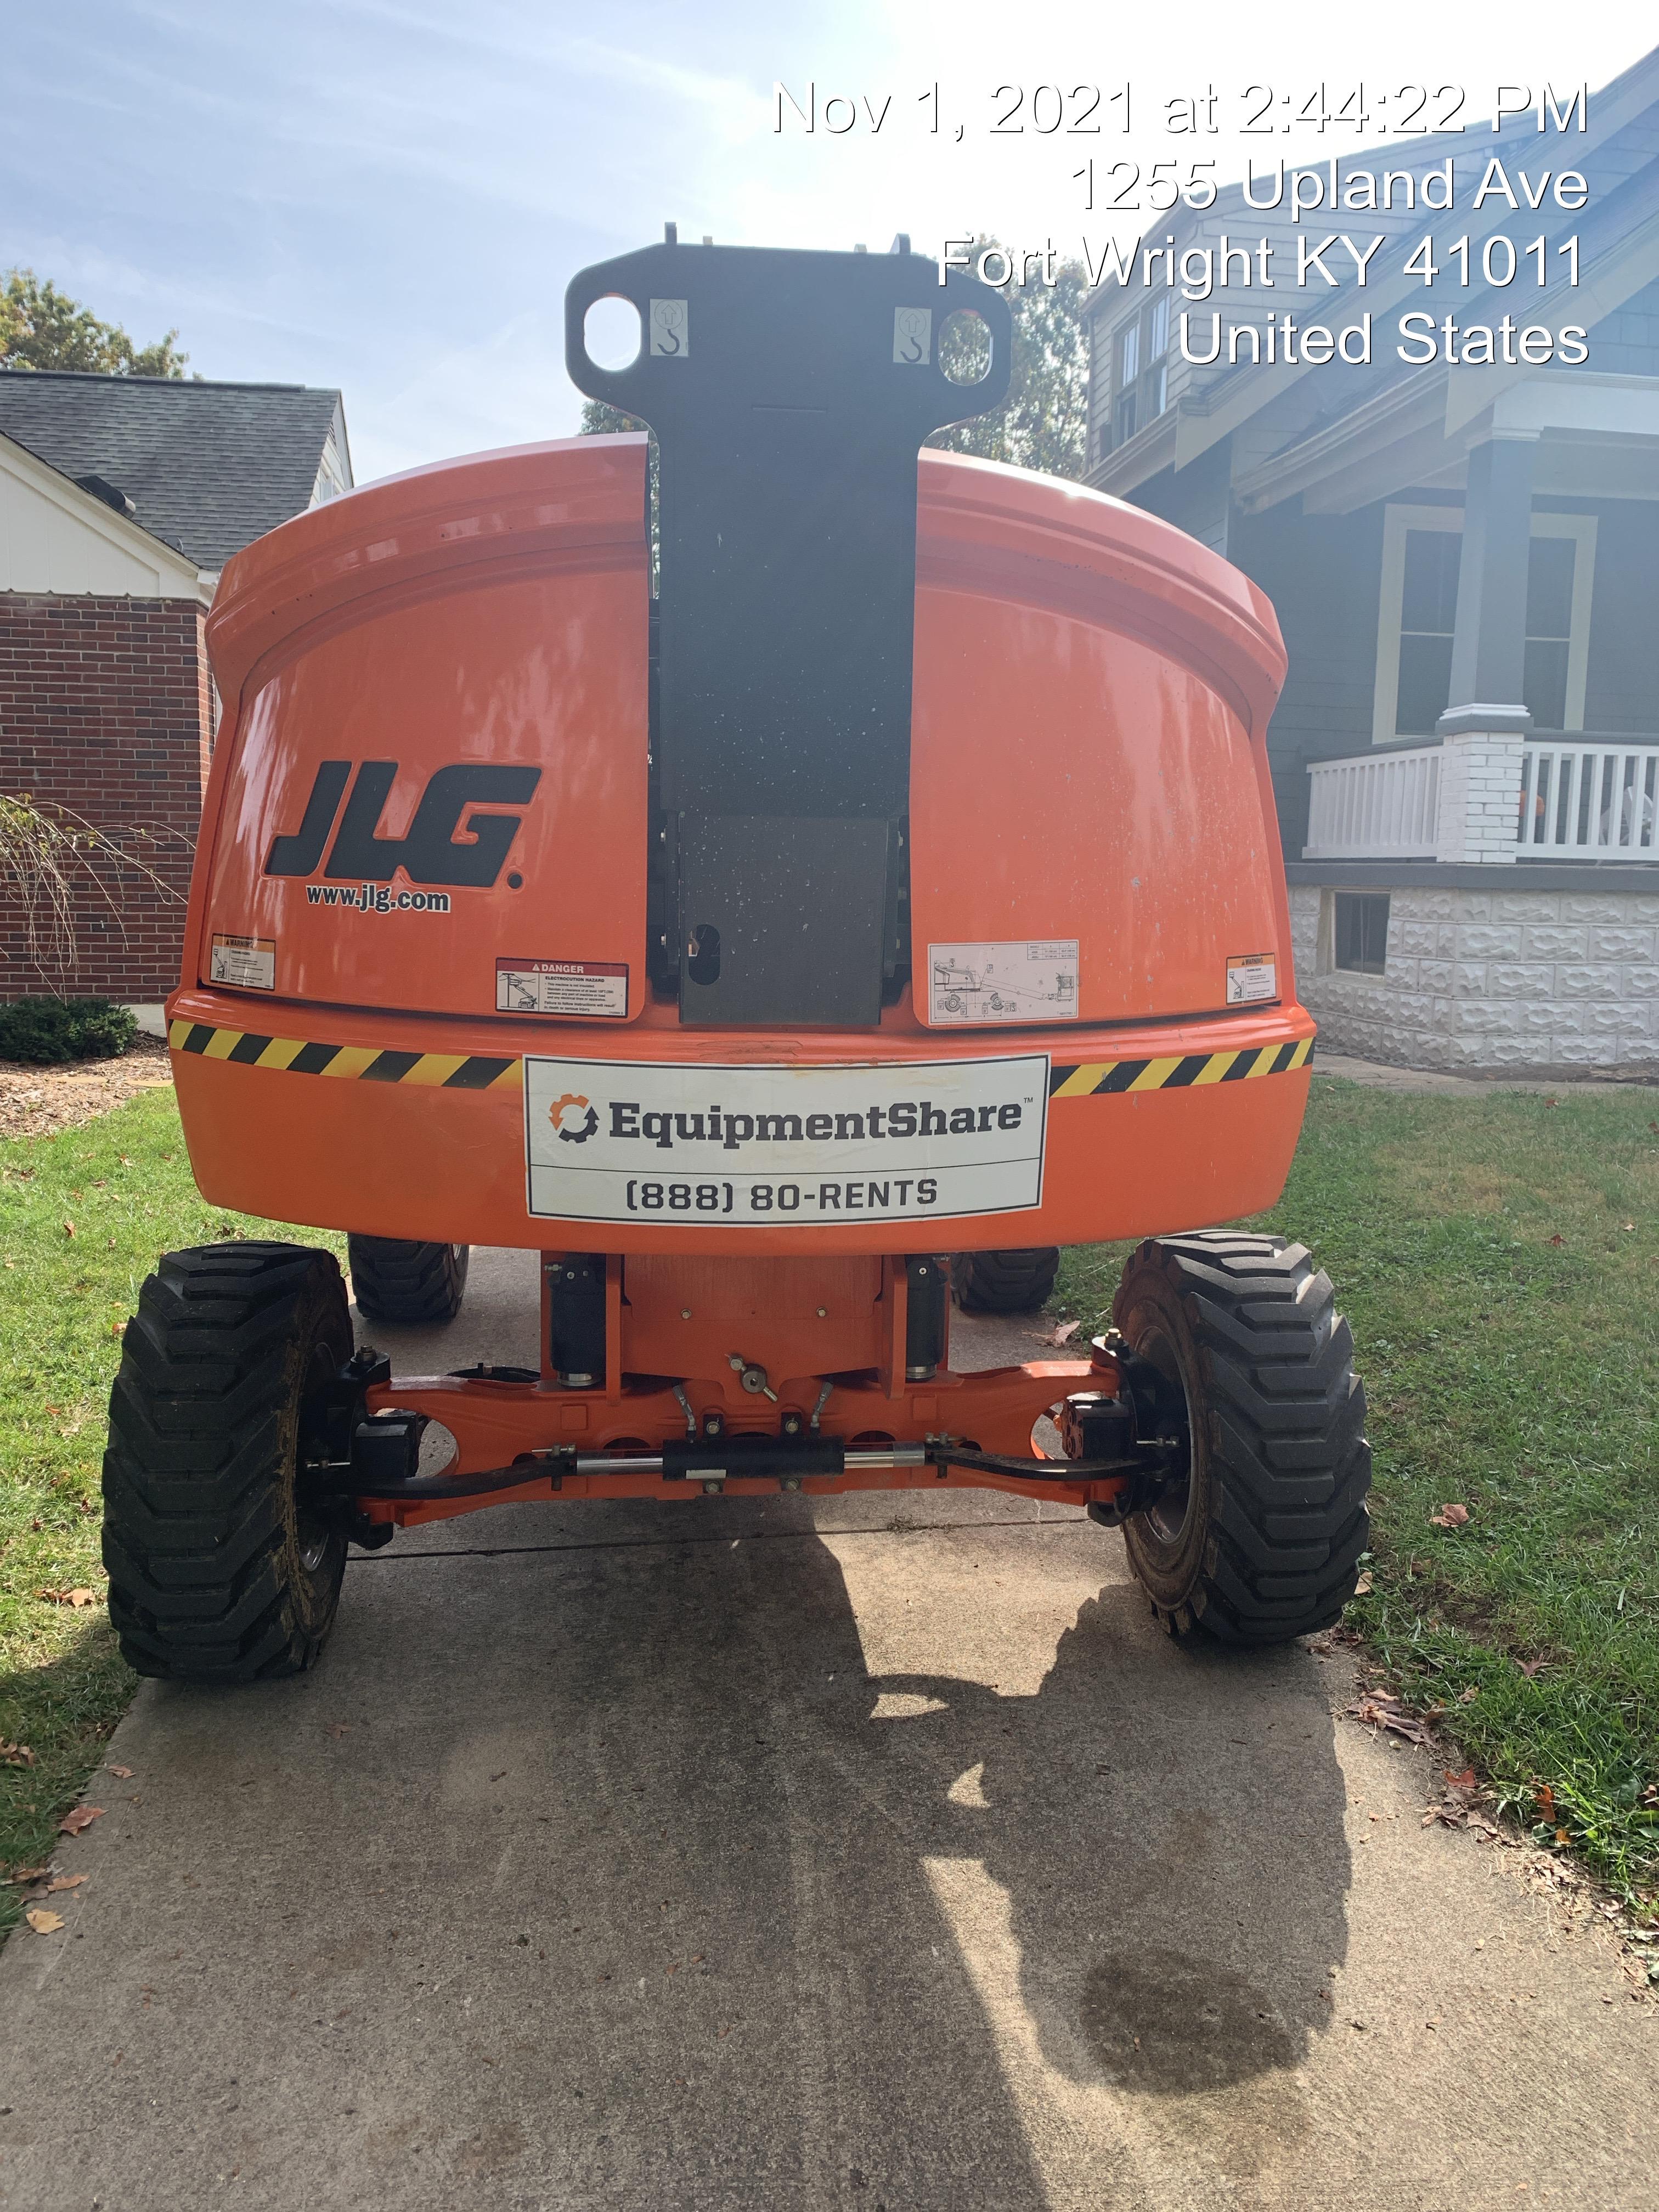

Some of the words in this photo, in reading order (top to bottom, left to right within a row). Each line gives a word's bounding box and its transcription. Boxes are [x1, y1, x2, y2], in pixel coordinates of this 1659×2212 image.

[306, 884, 450, 913] www.jlg.com
[541, 963, 584, 974] DANGER
[609, 1100, 1022, 1150] EquipmentShare
[625, 1180, 734, 1213] (888)
[750, 1177, 939, 1212] 80-RENTS
